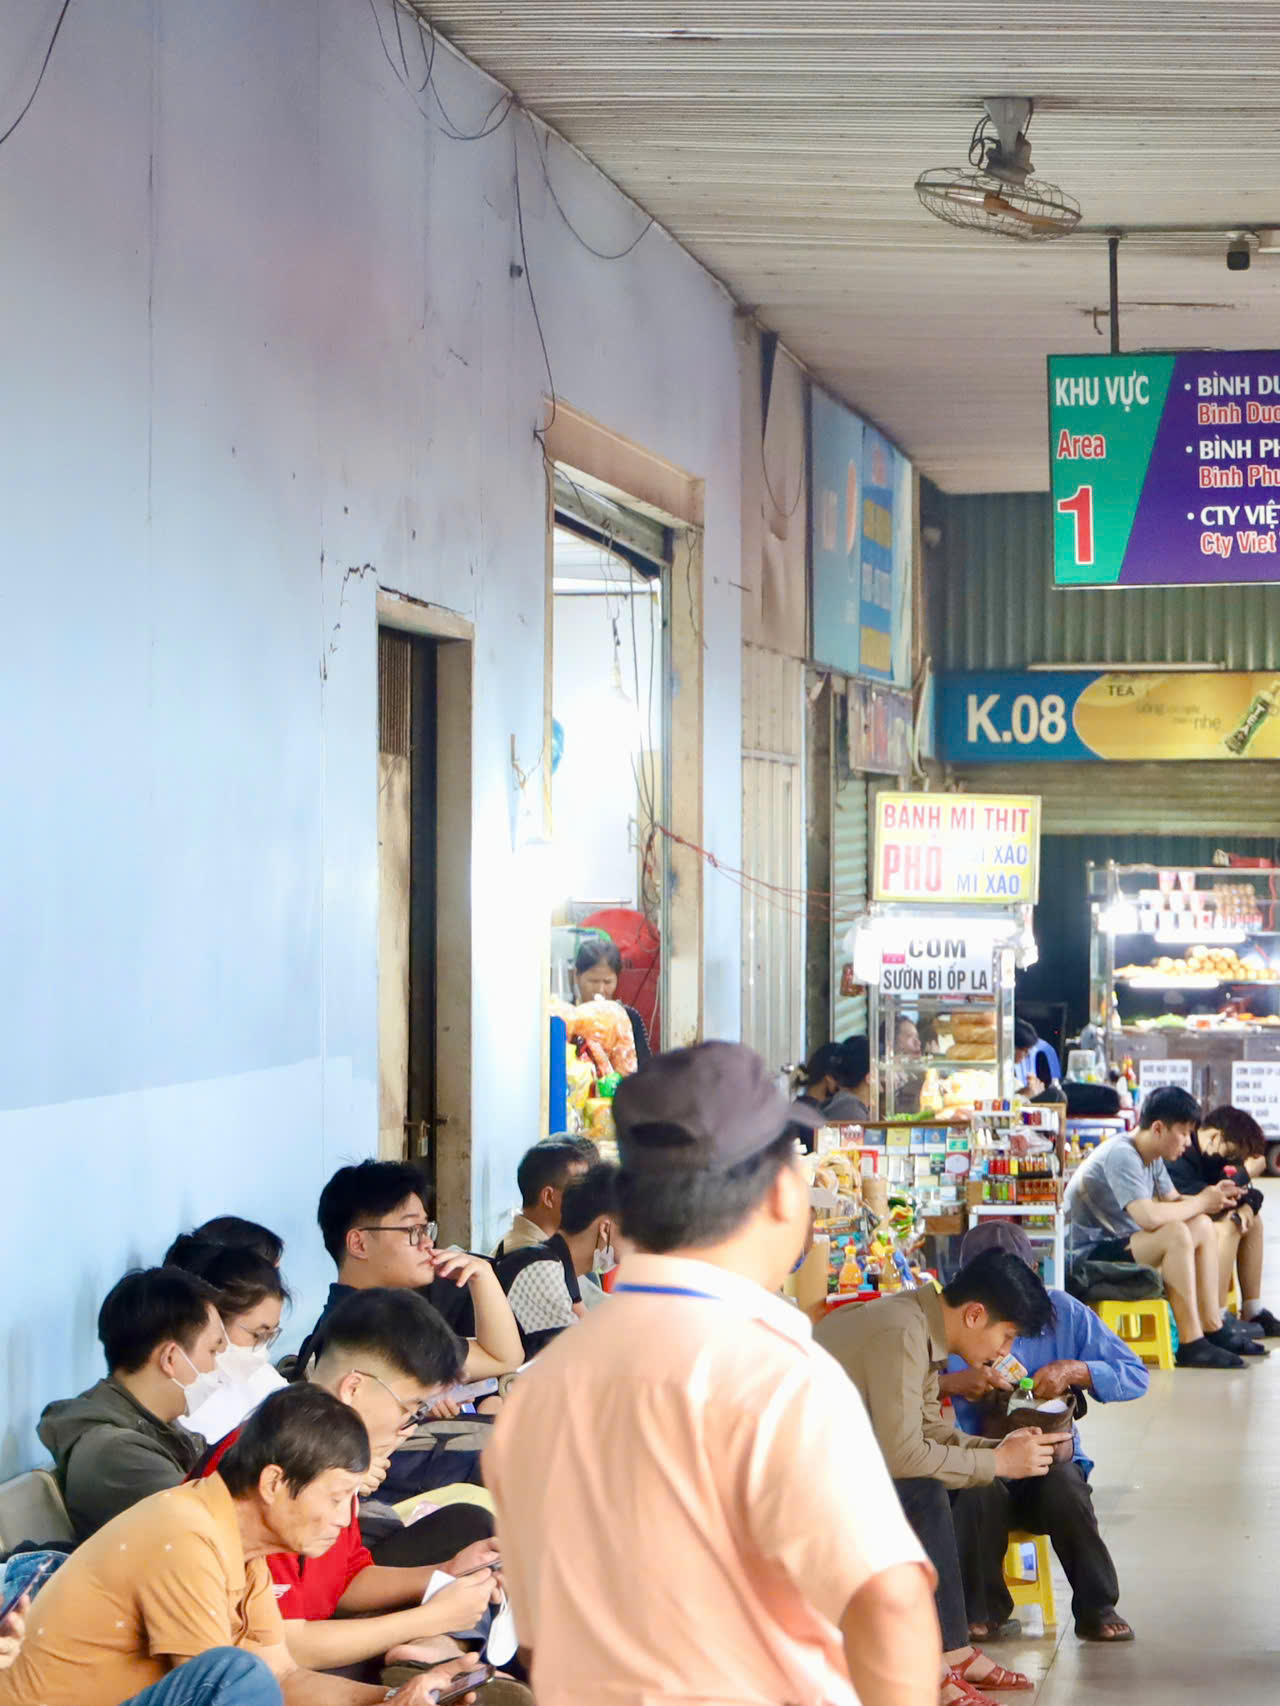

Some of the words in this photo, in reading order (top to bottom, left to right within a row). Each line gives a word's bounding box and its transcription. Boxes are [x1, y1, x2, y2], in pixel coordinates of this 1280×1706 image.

[1055, 376, 1098, 407] KHU
[1104, 370, 1150, 413] VỰC
[1197, 372, 1251, 397] BÌNH
[1197, 404, 1242, 425] Binh
[1057, 430, 1106, 459] Area
[1199, 434, 1252, 460] BÌNH
[1199, 466, 1244, 488] Binh
[1057, 484, 1095, 565] 1
[1200, 505, 1241, 527] CTY
[1199, 532, 1232, 559] Cty
[1236, 531, 1276, 554] Viet
[966, 693, 1067, 744] K.08
[970, 969, 988, 990] LA
